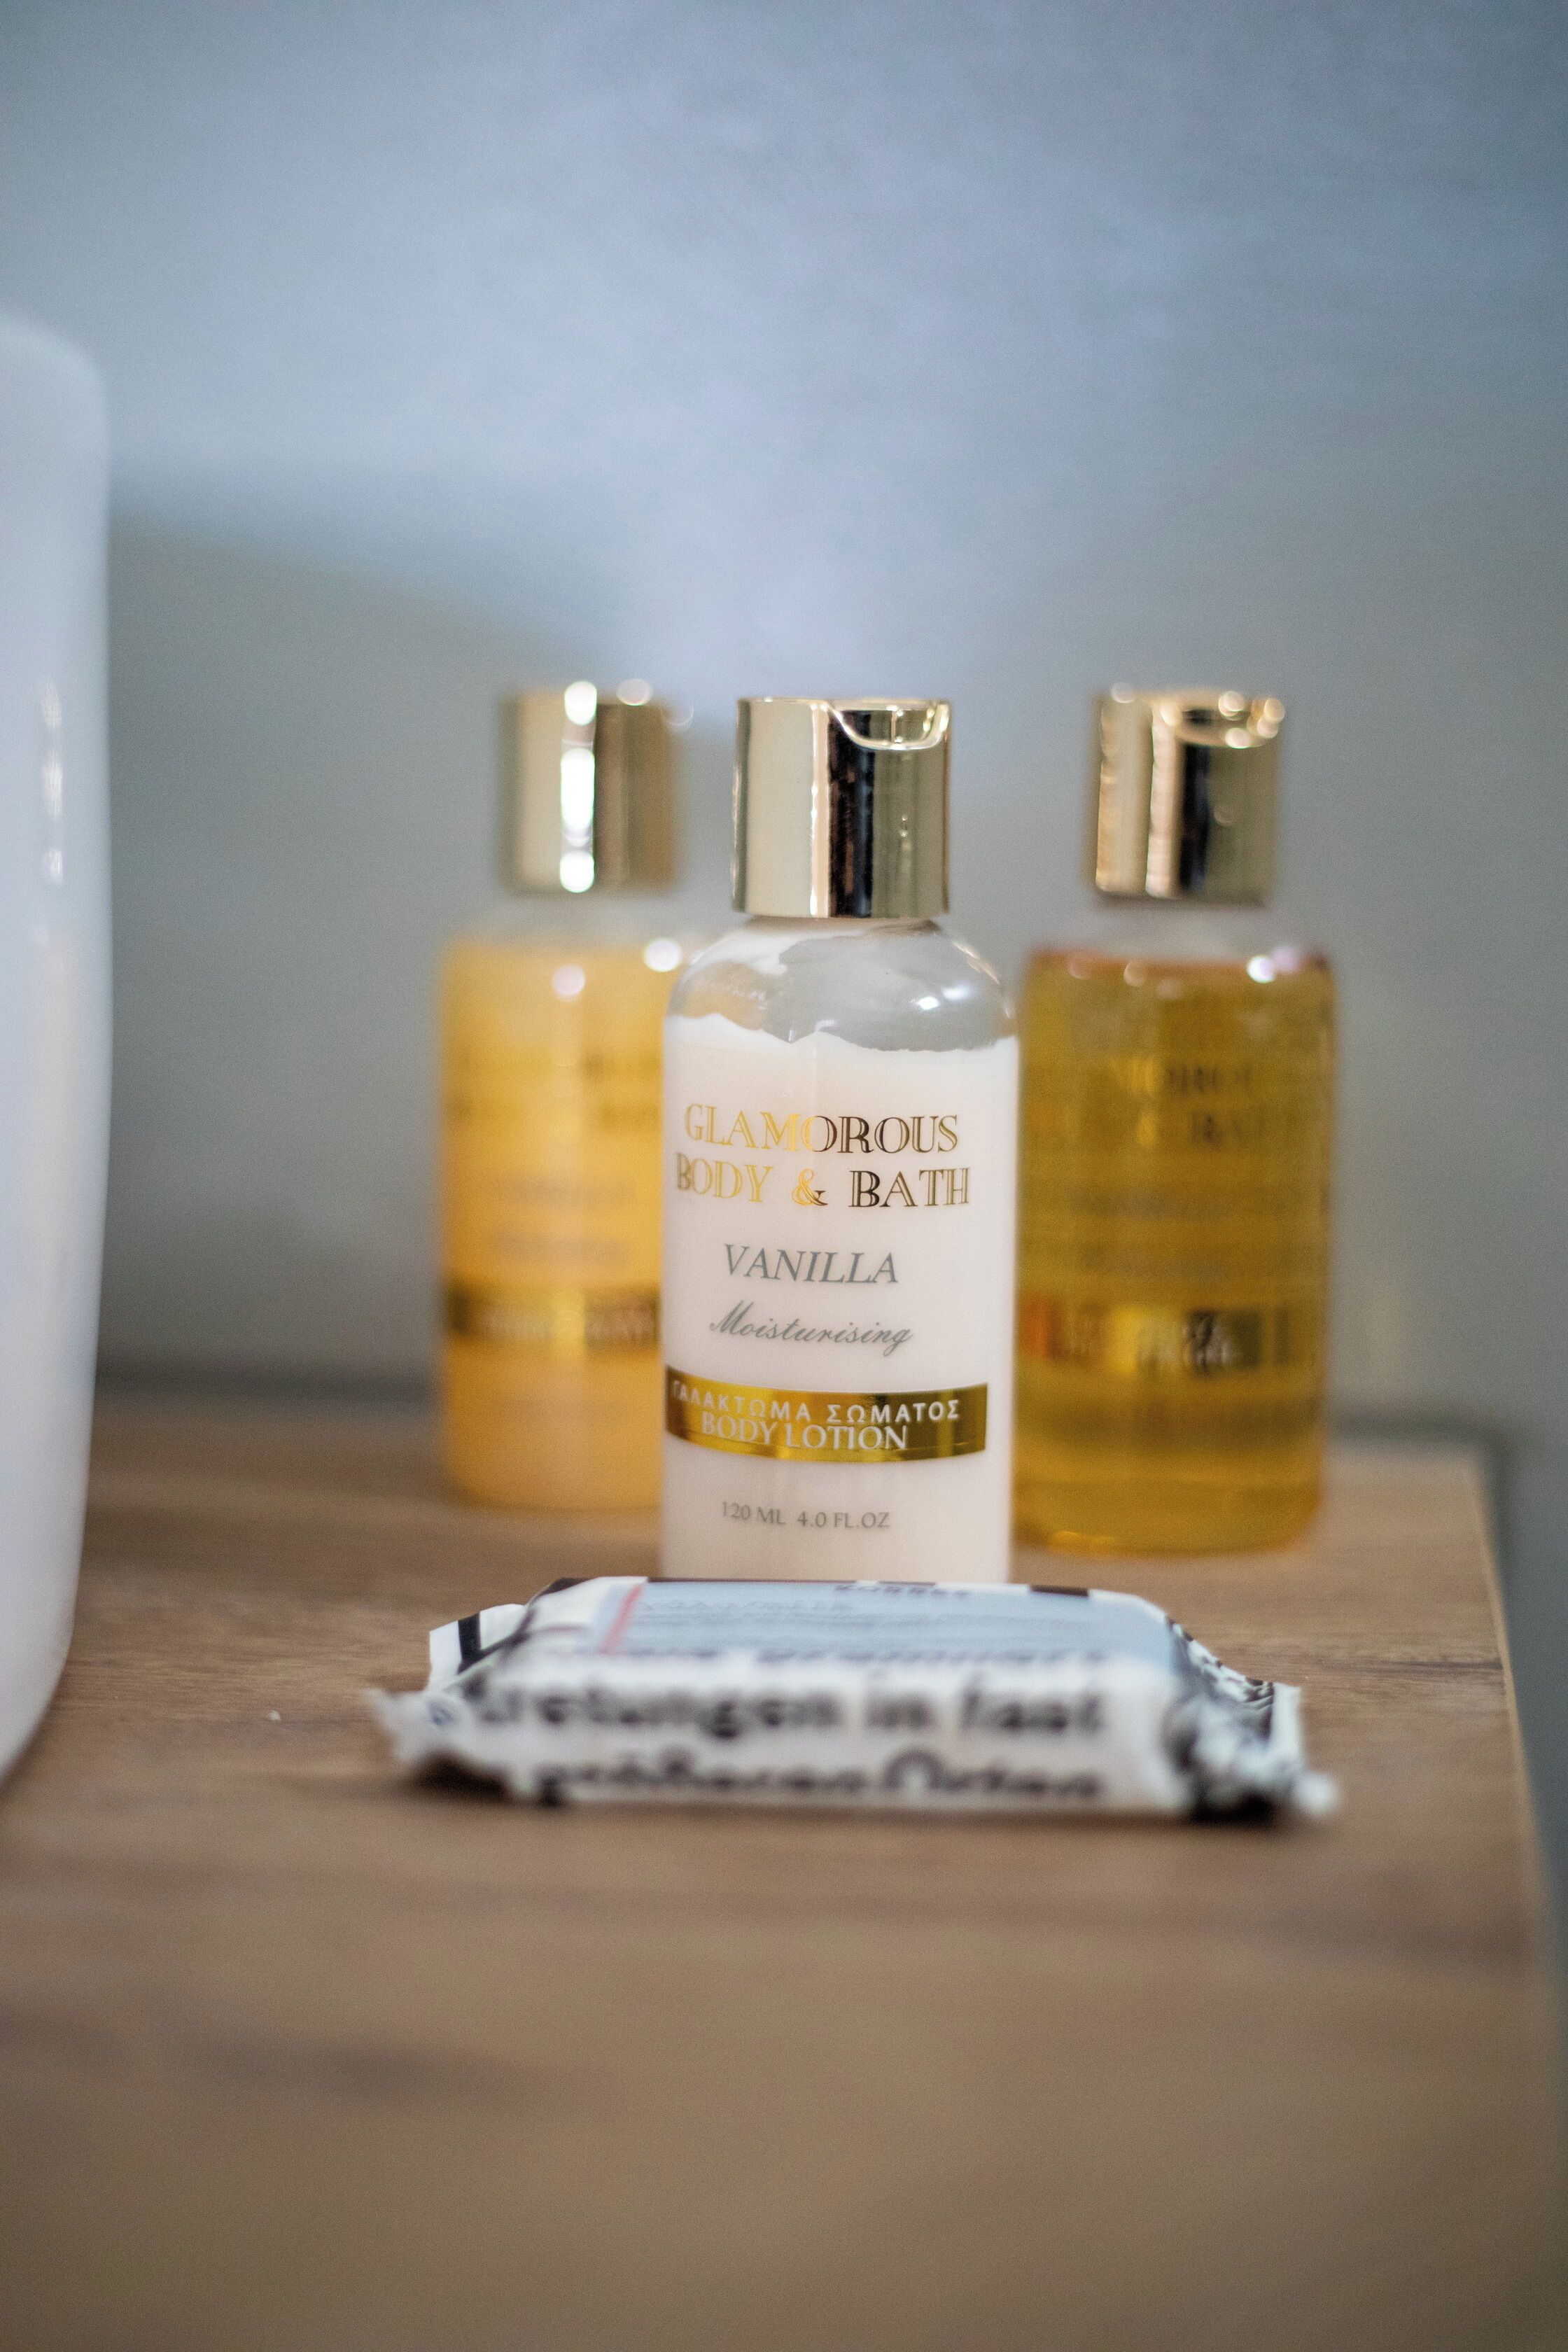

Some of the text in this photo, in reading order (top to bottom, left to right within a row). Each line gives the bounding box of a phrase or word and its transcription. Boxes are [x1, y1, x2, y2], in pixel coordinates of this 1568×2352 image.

[684, 1103, 958, 1154] GLAMOROUS
[676, 1152, 971, 1208] BODY & BATH
[724, 1243, 899, 1284] VANILLA
[709, 1299, 914, 1358] Moisturising
[701, 1410, 909, 1451] BODY LOTION
[721, 1501, 751, 1521] 120
[757, 1506, 786, 1526] ML
[797, 1510, 827, 1529] 4.0
